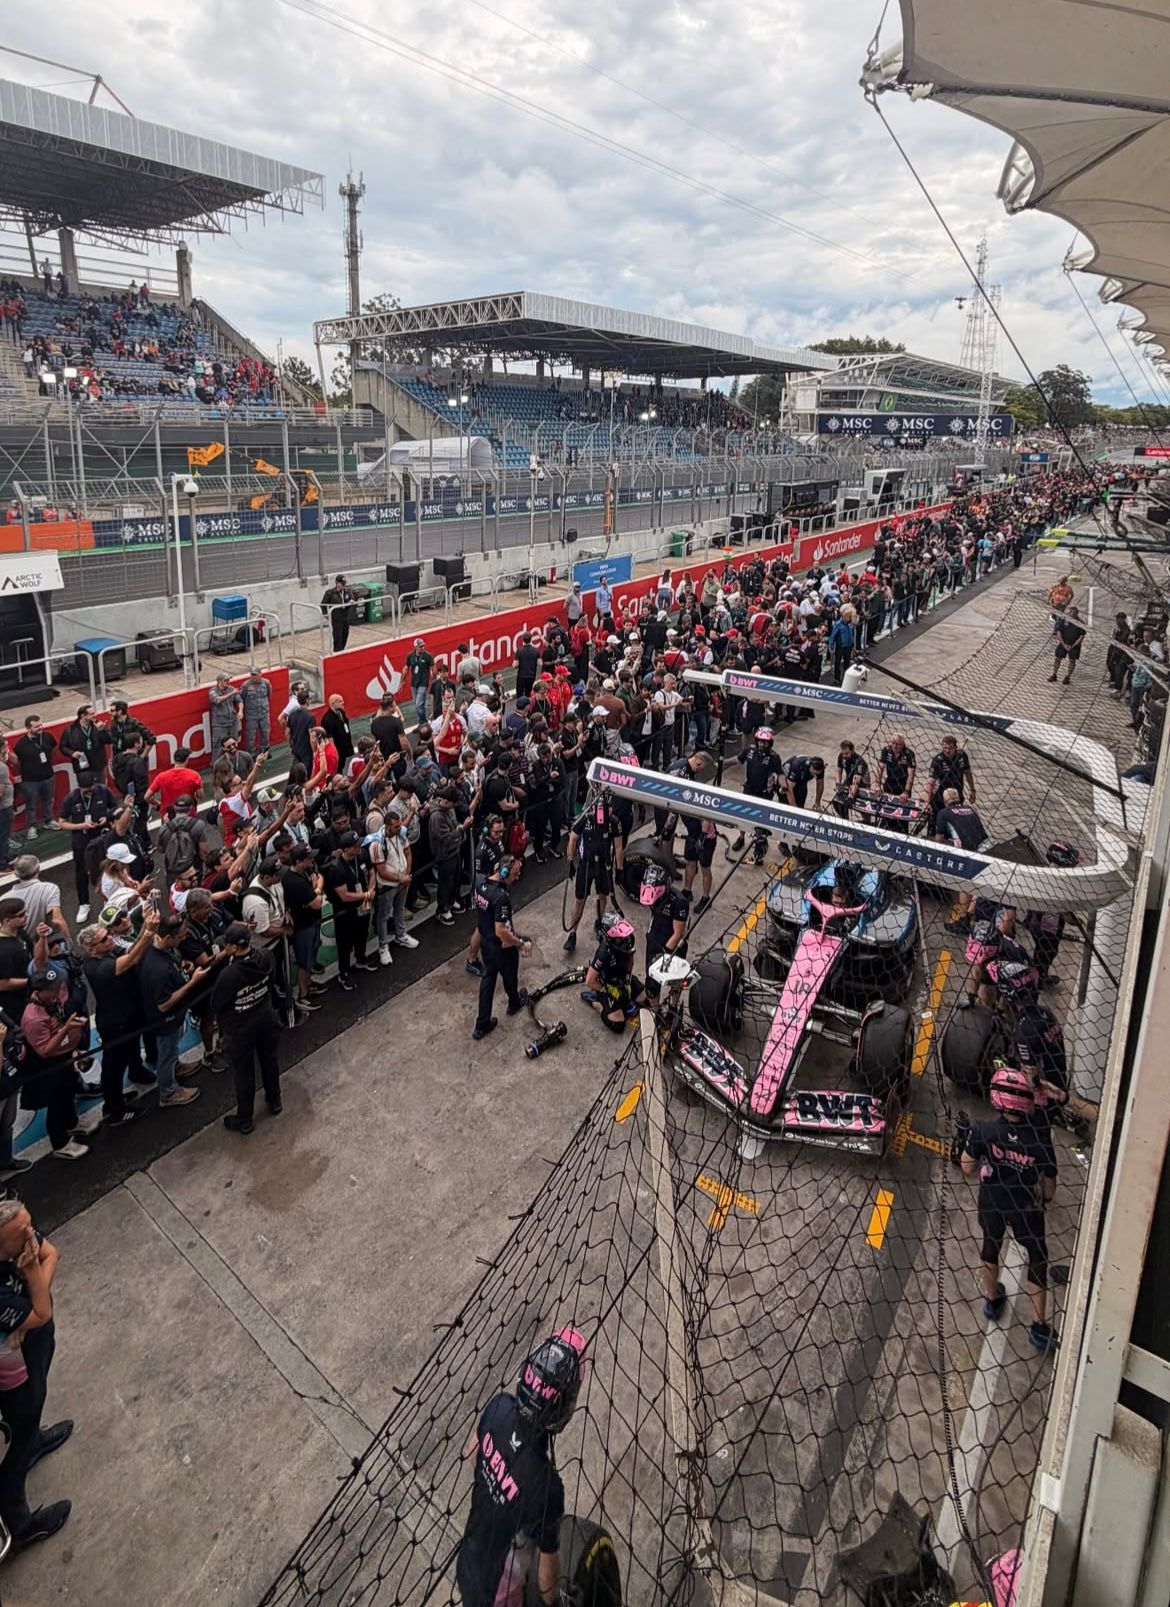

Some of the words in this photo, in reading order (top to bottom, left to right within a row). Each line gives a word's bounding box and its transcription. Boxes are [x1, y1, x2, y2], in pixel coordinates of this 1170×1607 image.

[842, 418, 872, 429] MSC
[902, 418, 934, 429] MSC
[967, 418, 1002, 430] MSC
[424, 504, 443, 515] MSC
[464, 502, 482, 511] MSC
[330, 511, 354, 522] MSC
[380, 507, 401, 518] MSC
[211, 518, 241, 531] MSC
[824, 533, 861, 557] Santander
[16, 573, 43, 581] ARCTIC
[20, 580, 41, 588] WOLF
[432, 621, 549, 676] antander
[737, 677, 758, 688] BWT
[801, 688, 823, 698] MSC
[609, 771, 636, 788] BWT
[693, 791, 721, 808] MSC
[769, 813, 798, 827] BETTER
[799, 820, 825, 835] NEVER
[827, 827, 853, 842] STOPS
[895, 845, 965, 872] CASTORE
